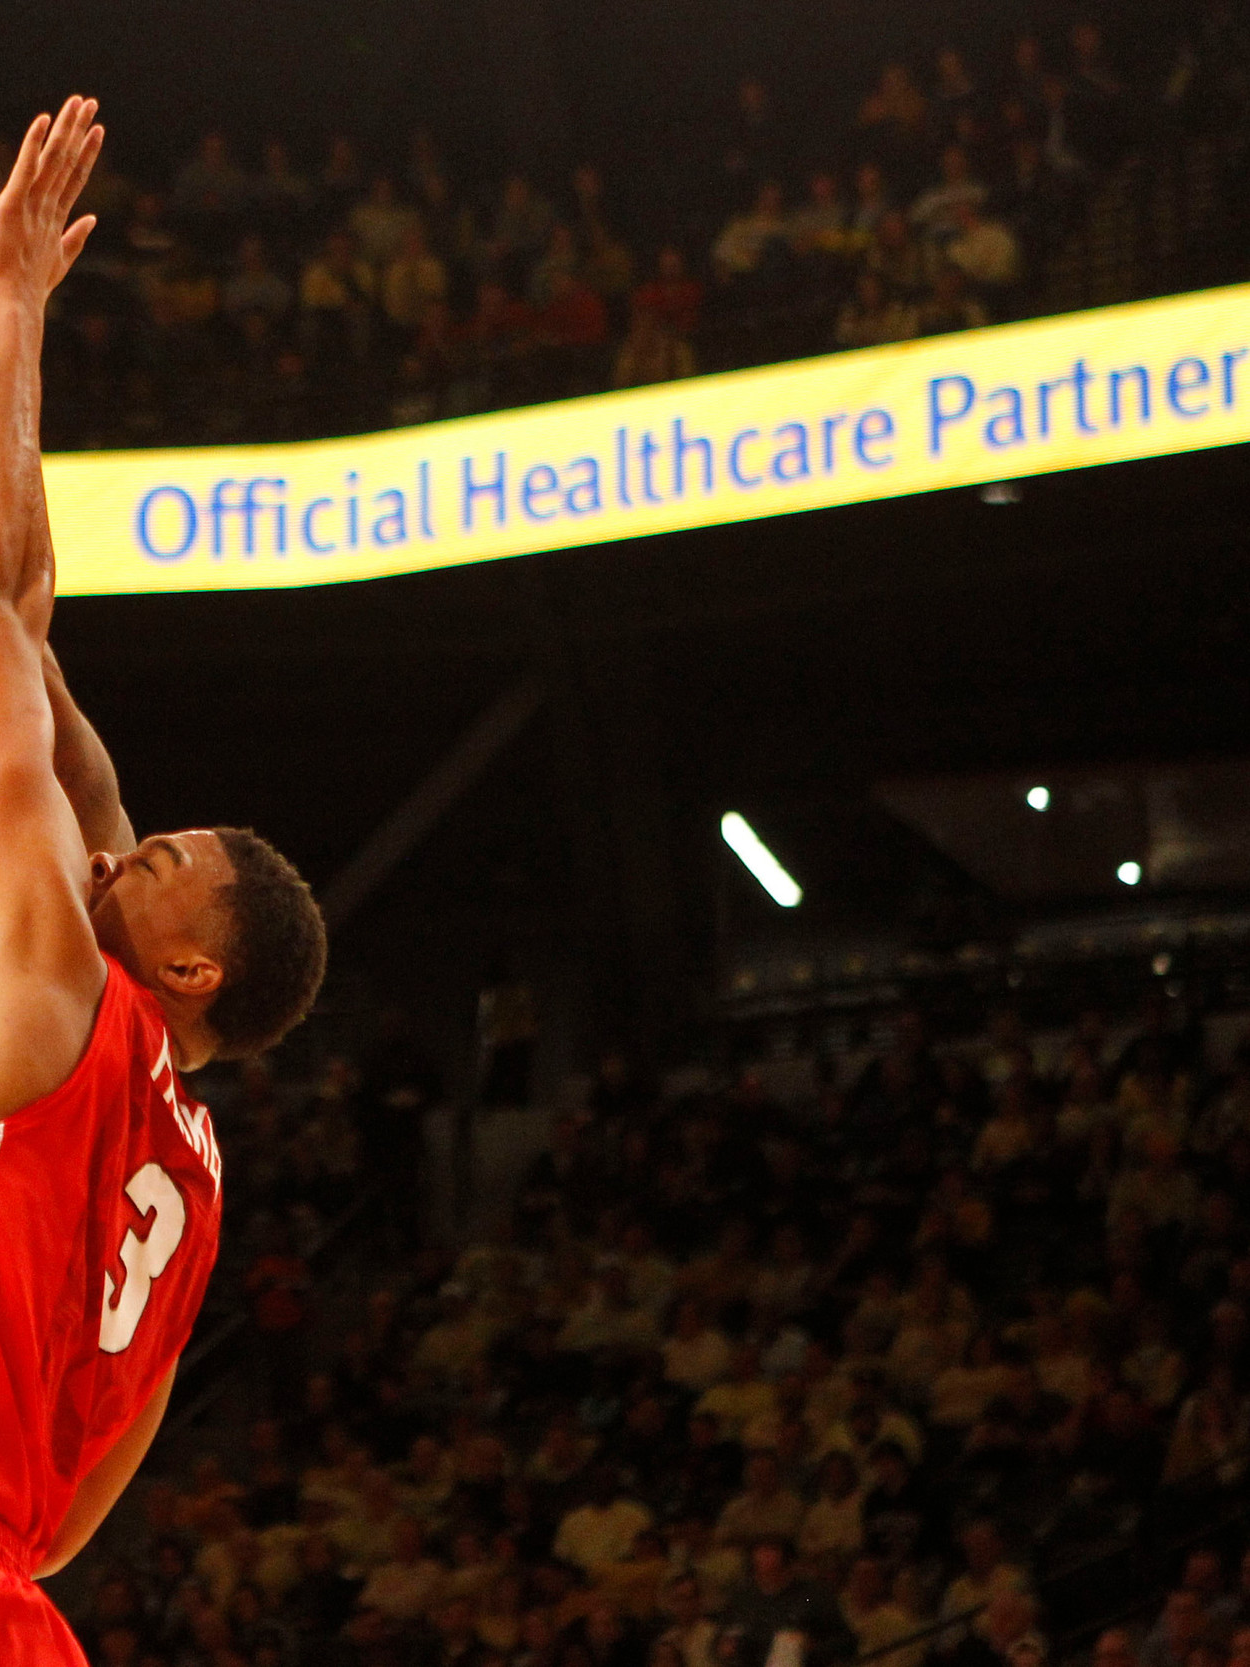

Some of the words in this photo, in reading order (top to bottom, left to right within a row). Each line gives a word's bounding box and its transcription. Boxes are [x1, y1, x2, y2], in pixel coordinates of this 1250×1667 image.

[136, 470, 435, 560] Official
[461, 405, 895, 532] Healthcare
[926, 347, 1250, 457] Partner
[98, 1162, 186, 1353] 3
